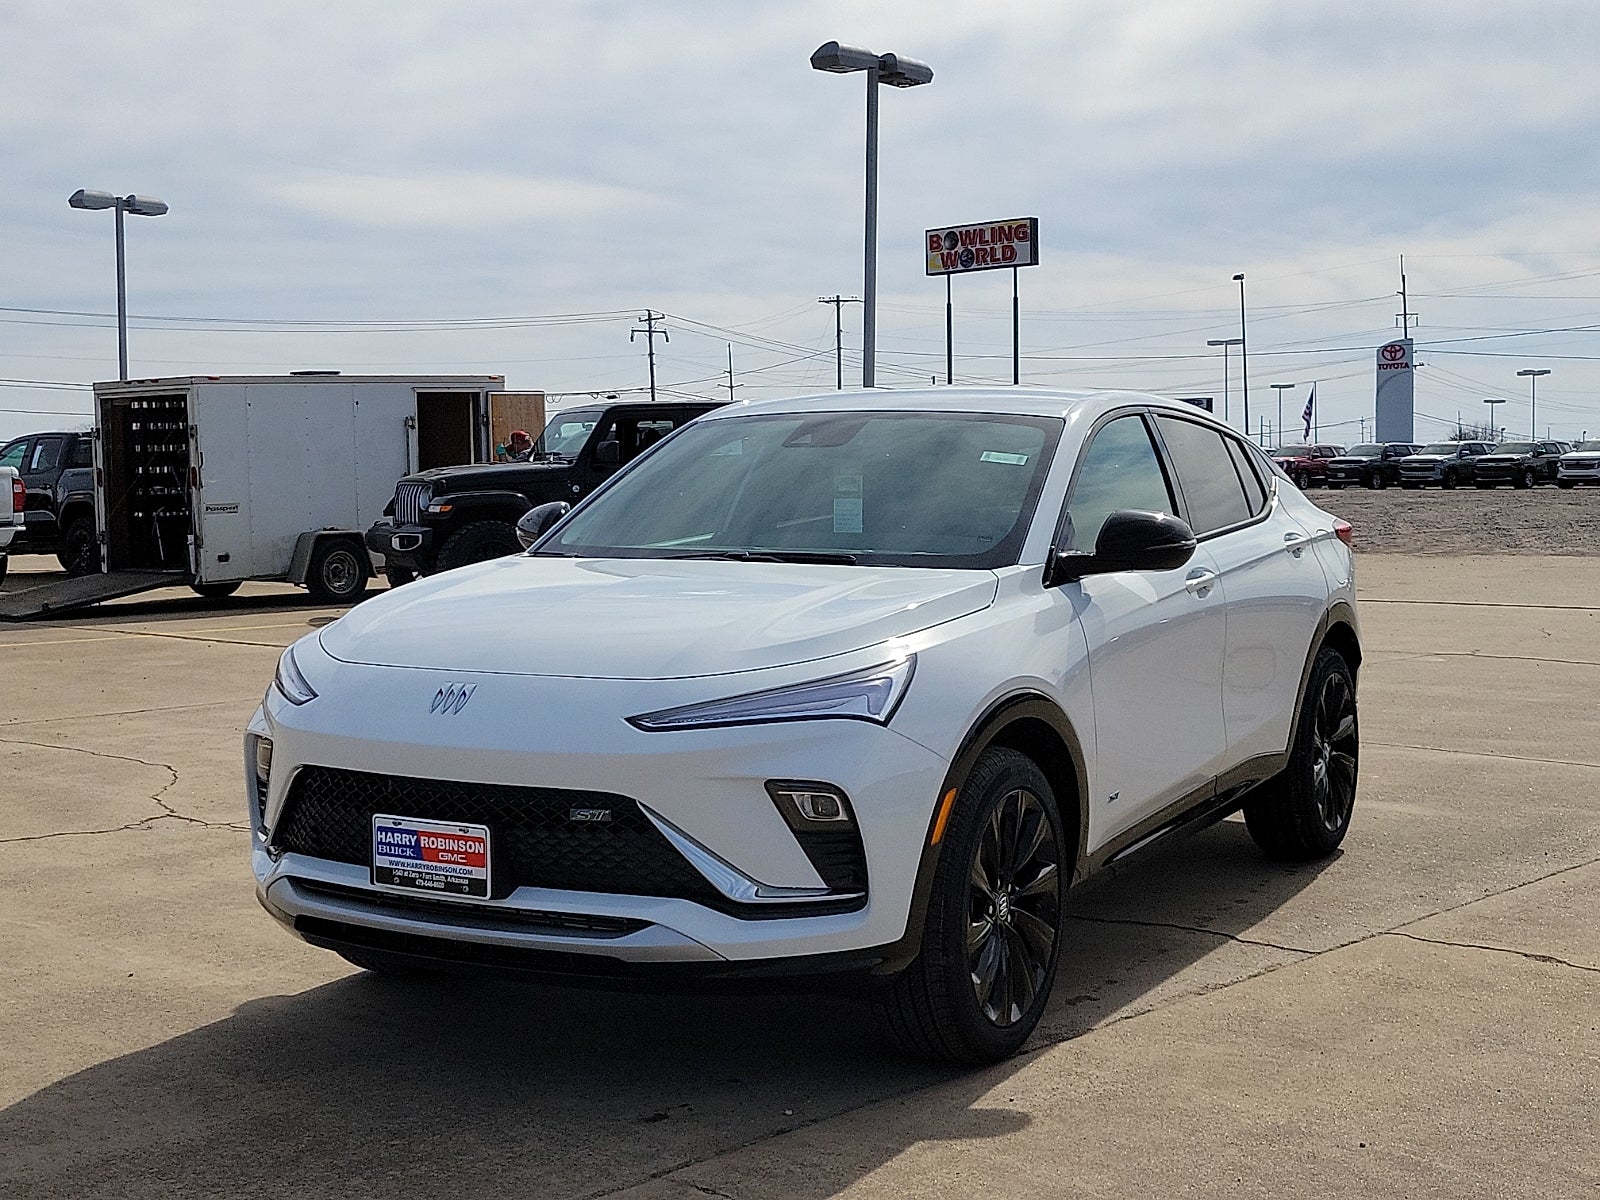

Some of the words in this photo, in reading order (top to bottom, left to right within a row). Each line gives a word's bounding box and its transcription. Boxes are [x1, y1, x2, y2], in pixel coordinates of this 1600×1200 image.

[929, 223, 1030, 253] BOWLING
[940, 244, 1017, 270] WORLD
[1377, 362, 1410, 370] TOYOTA
[377, 831, 418, 846] HARRY
[420, 836, 485, 854] ROBINSON
[378, 844, 416, 857] BUICK
[438, 852, 468, 863] GMC
[388, 859, 474, 876] WWW.HARRYROBINSON.COM
